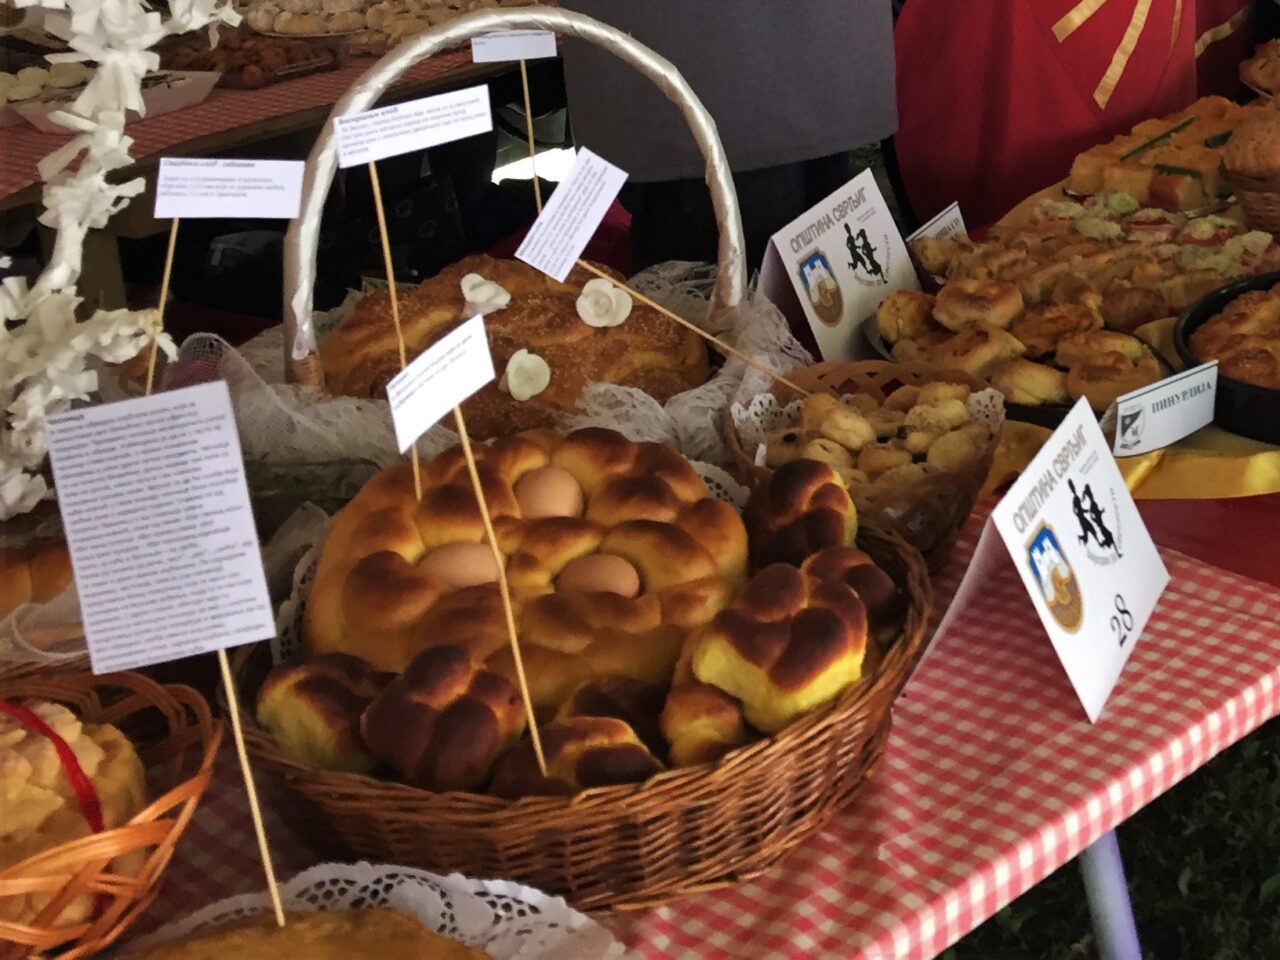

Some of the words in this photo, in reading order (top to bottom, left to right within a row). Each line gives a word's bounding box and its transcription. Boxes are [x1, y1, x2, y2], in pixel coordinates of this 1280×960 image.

[790, 214, 836, 254] ОПШТИНА
[832, 186, 867, 223] СВРЉИГ
[1012, 469, 1058, 534] ОПШТИНА
[1052, 424, 1087, 478] СВРЉИГ
[1110, 593, 1135, 648] 28
